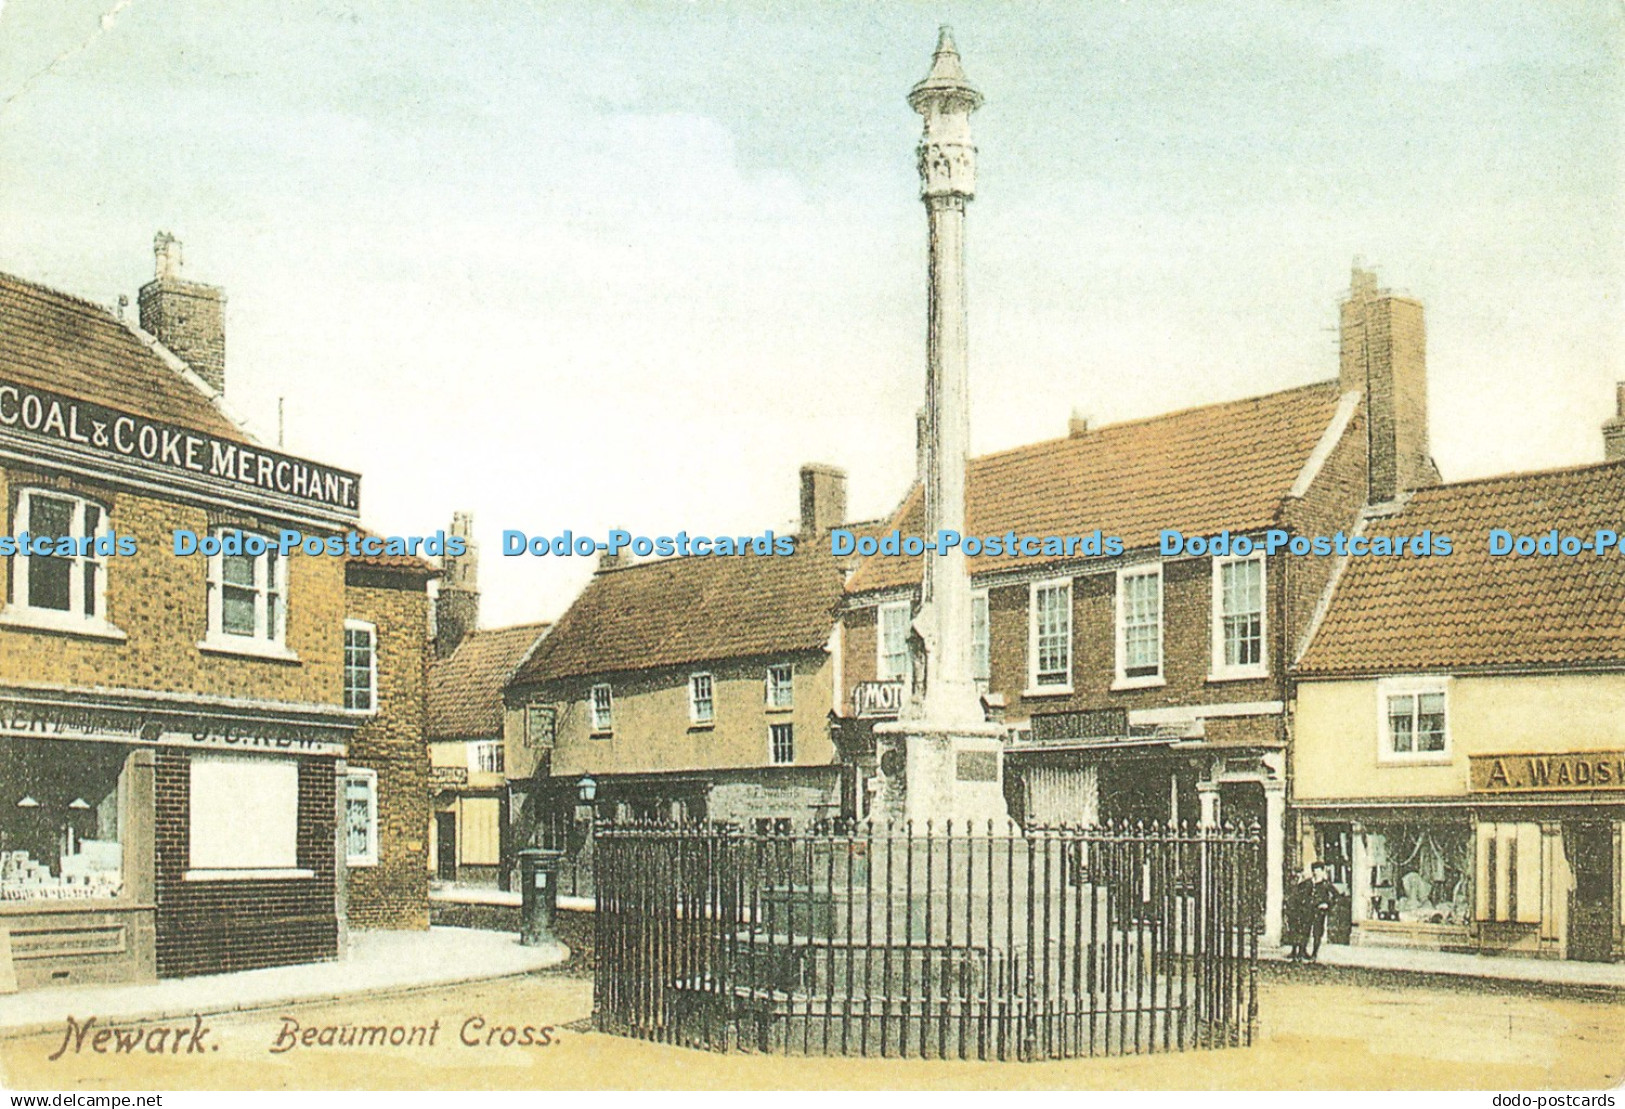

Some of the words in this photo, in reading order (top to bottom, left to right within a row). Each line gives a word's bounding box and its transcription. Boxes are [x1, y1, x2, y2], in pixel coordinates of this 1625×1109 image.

[0, 385, 90, 443] COAL
[114, 416, 204, 471] COKE
[209, 440, 355, 507] MERCHANT.
[1529, 757, 1625, 787] WADS
